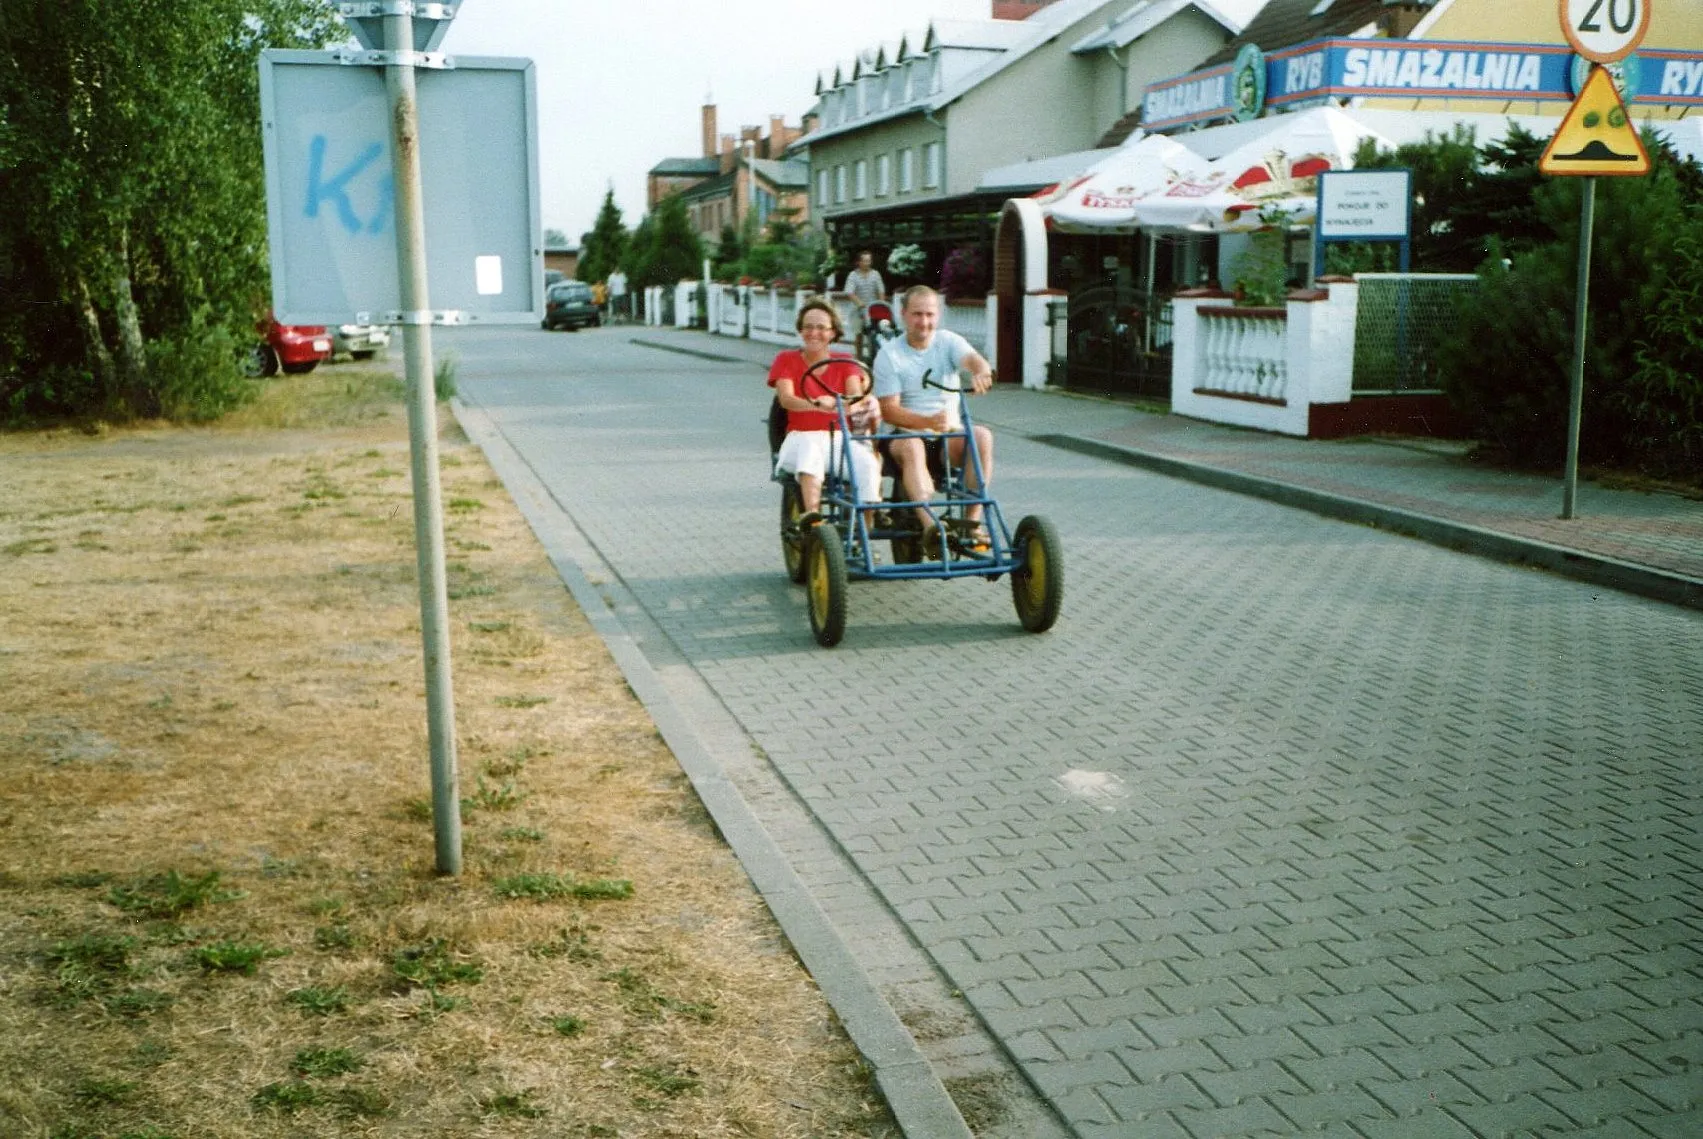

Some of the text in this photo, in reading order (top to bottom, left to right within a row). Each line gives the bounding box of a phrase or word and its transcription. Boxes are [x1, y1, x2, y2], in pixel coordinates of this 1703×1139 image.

[1577, 0, 1636, 34] 20
[1285, 52, 1324, 93] RYB
[1342, 48, 1703, 95] SMAŻALNIA RY
